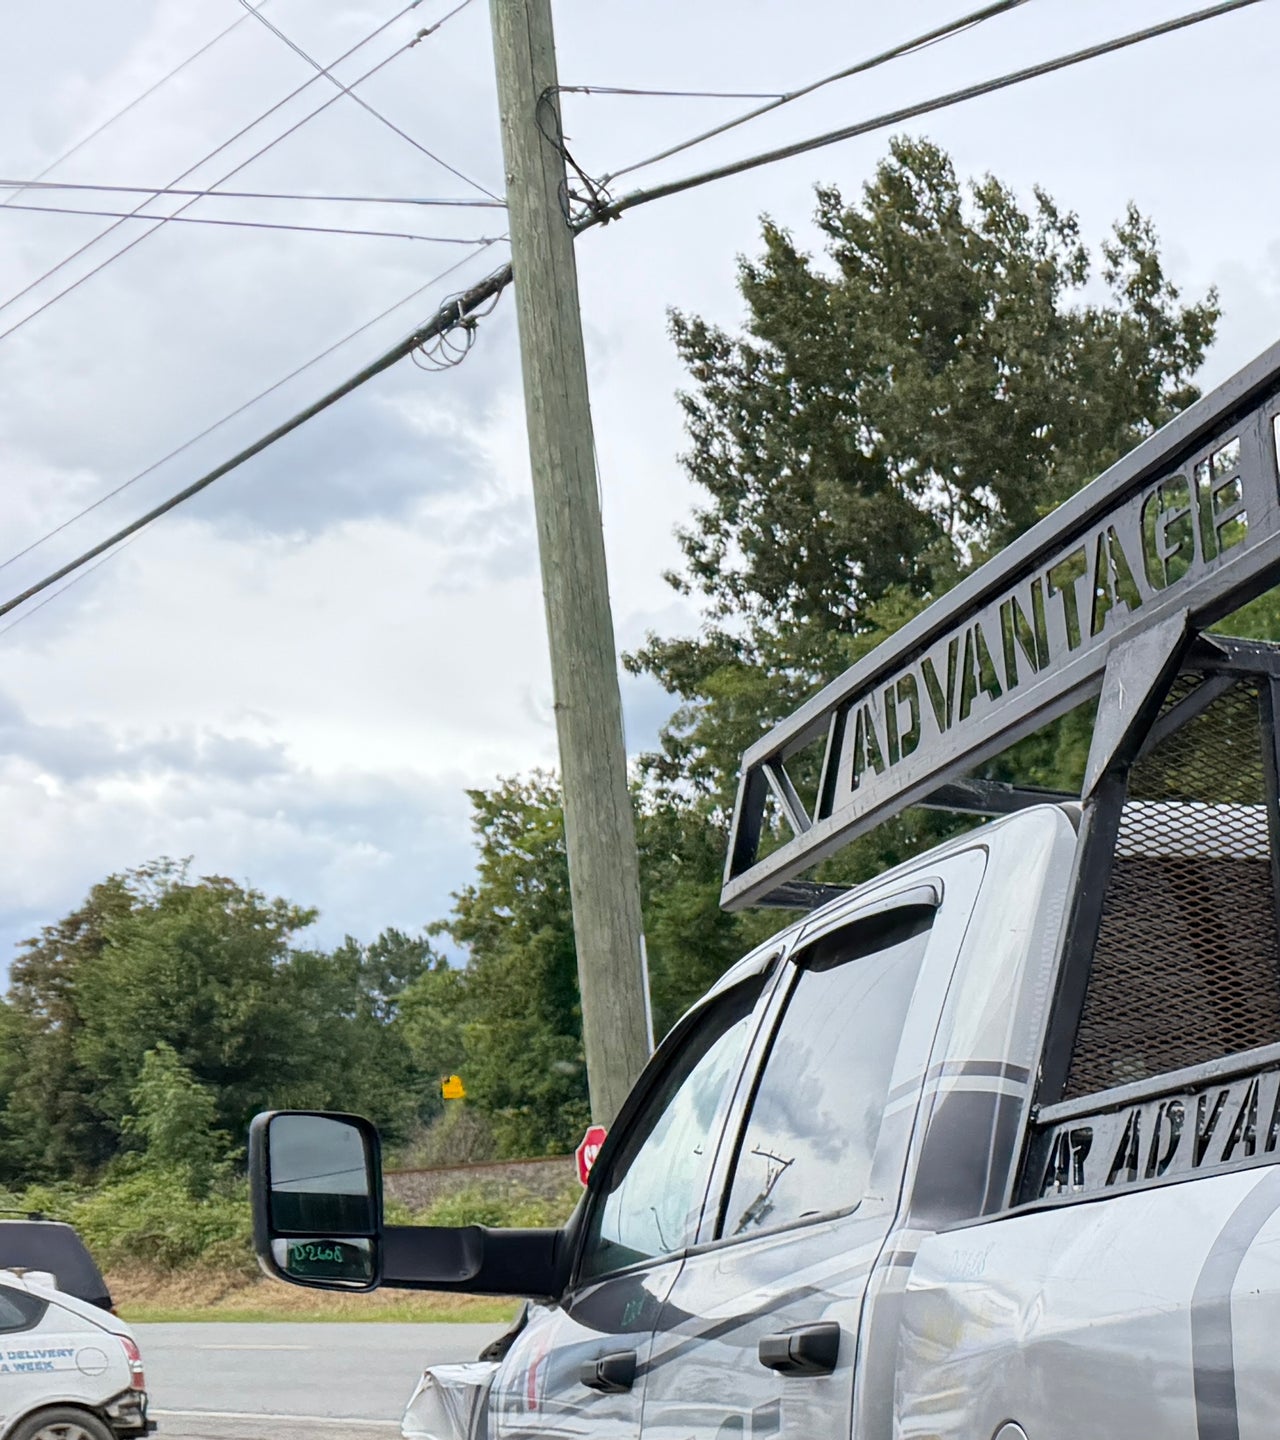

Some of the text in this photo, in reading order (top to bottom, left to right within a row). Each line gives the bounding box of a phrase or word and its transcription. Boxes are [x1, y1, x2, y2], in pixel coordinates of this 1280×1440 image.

[851, 436, 1248, 791] ADVANTAGE
[7, 1348, 75, 1360] DELIVERY
[13, 1361, 54, 1372] WEEK
